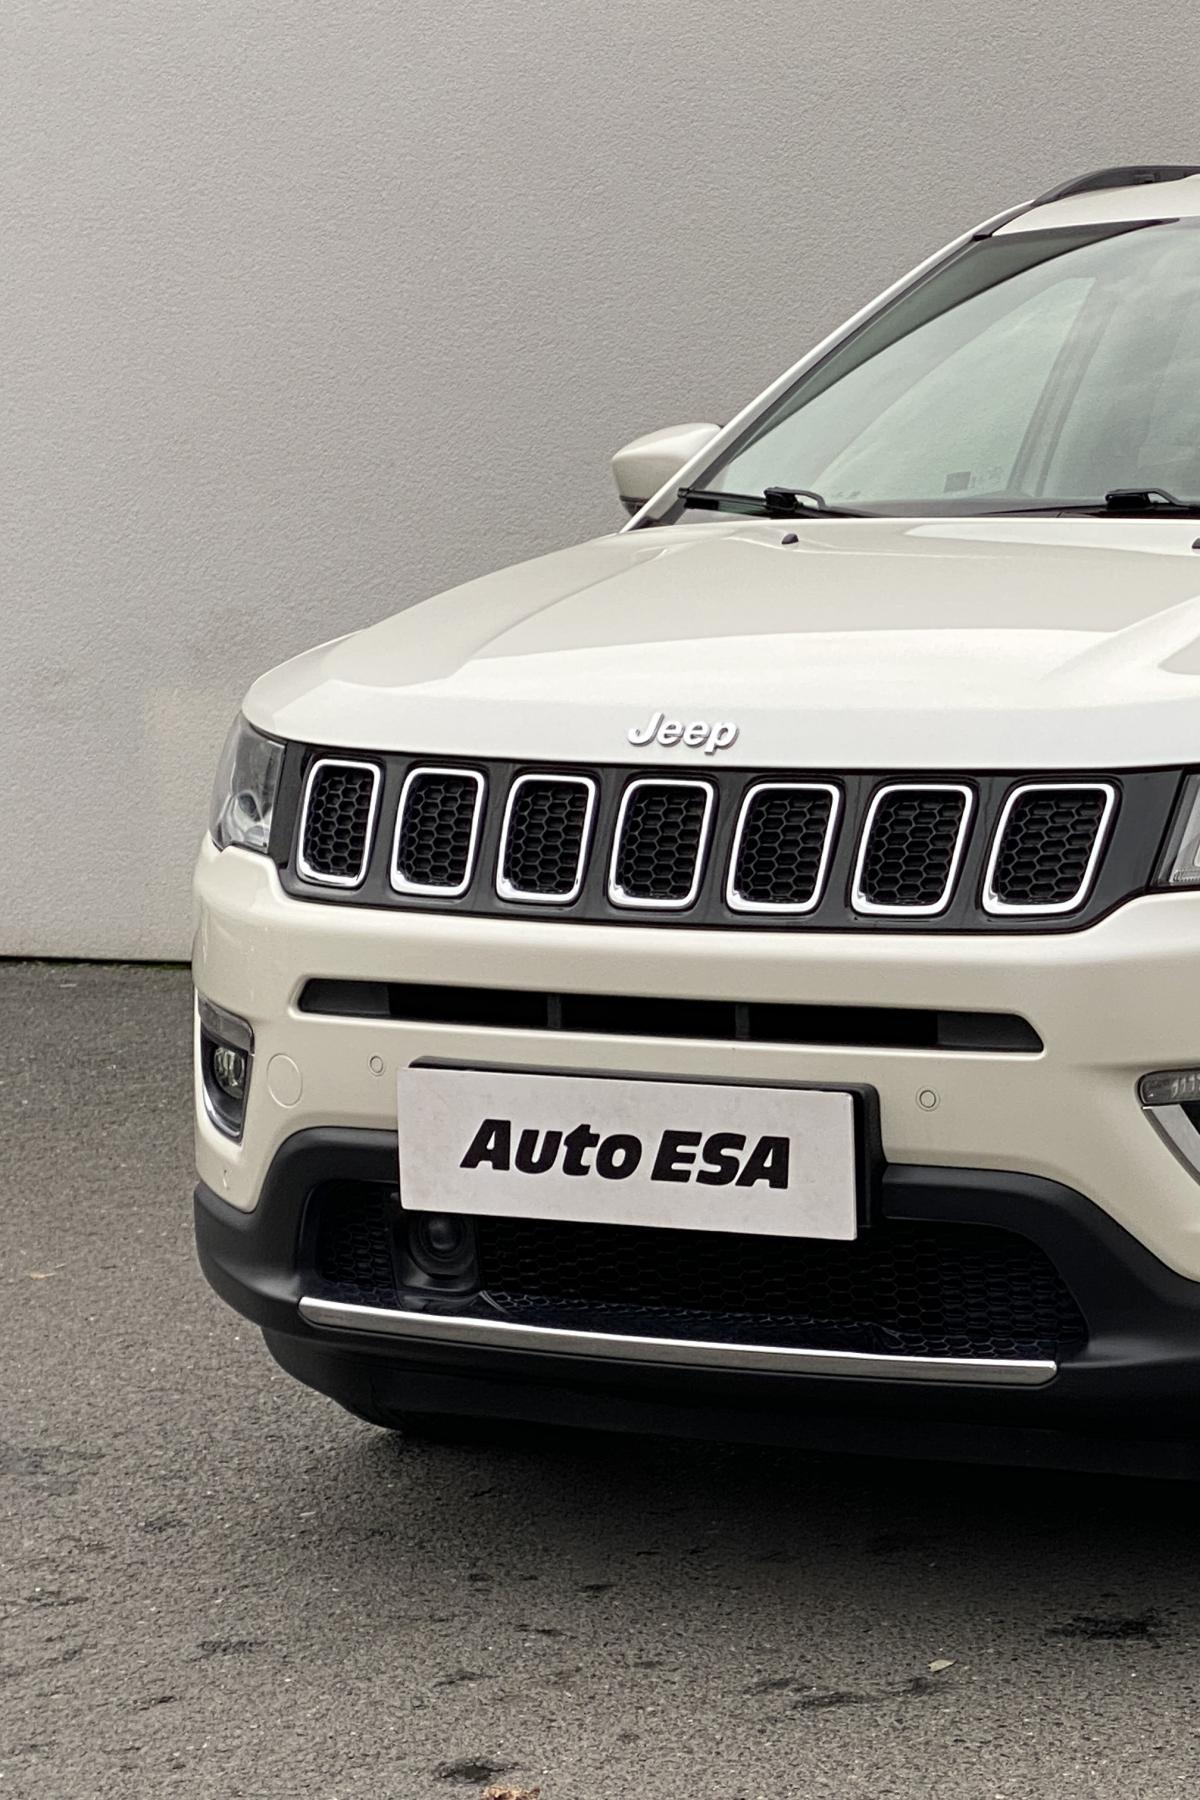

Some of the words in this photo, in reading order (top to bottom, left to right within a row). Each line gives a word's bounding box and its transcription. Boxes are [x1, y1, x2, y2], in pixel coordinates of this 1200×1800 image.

[627, 712, 739, 756] Jeep
[460, 1118, 643, 1180] Auto
[651, 1129, 791, 1190] ESA
